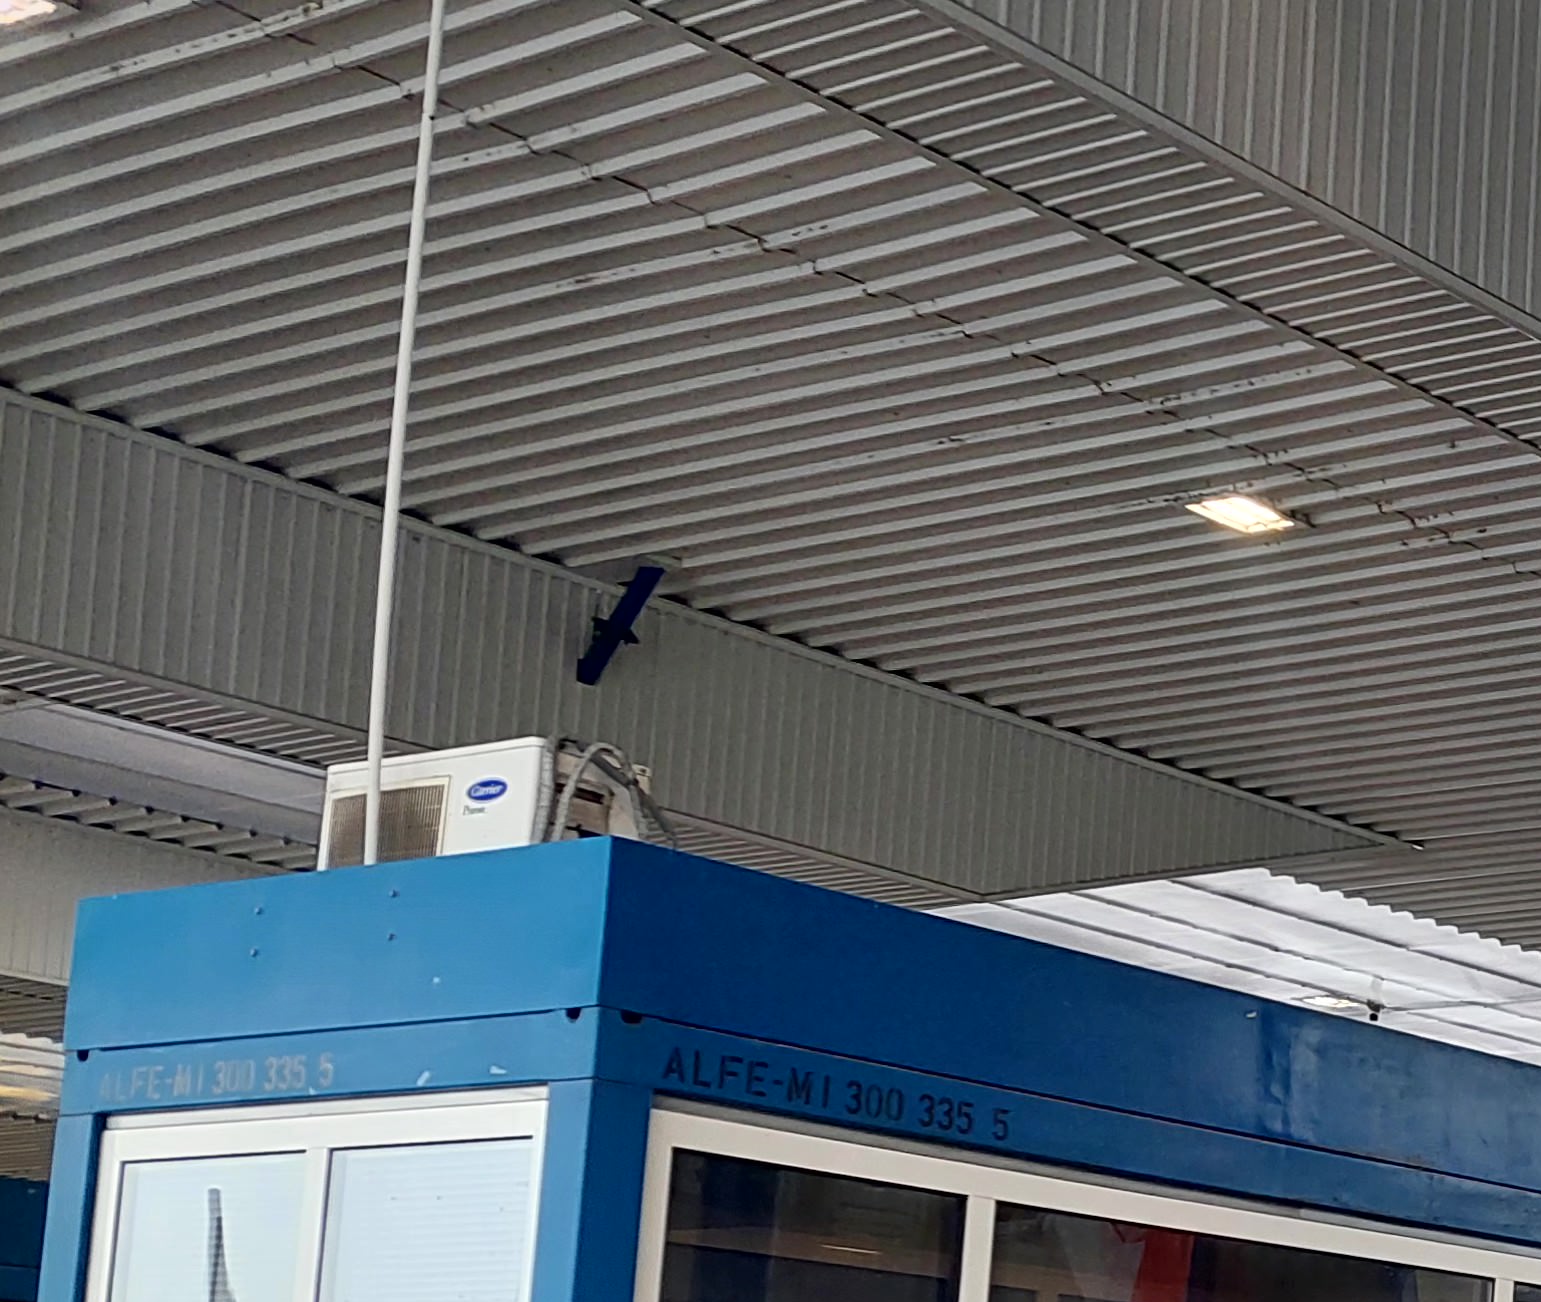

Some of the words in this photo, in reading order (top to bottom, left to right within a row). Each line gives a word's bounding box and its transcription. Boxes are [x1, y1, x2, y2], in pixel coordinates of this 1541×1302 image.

[211, 1059, 256, 1096] 300
[264, 1054, 308, 1092] 335
[319, 1051, 335, 1088] 5
[845, 1079, 903, 1121] 300
[918, 1093, 975, 1135] 335
[991, 1107, 1012, 1142] 5
